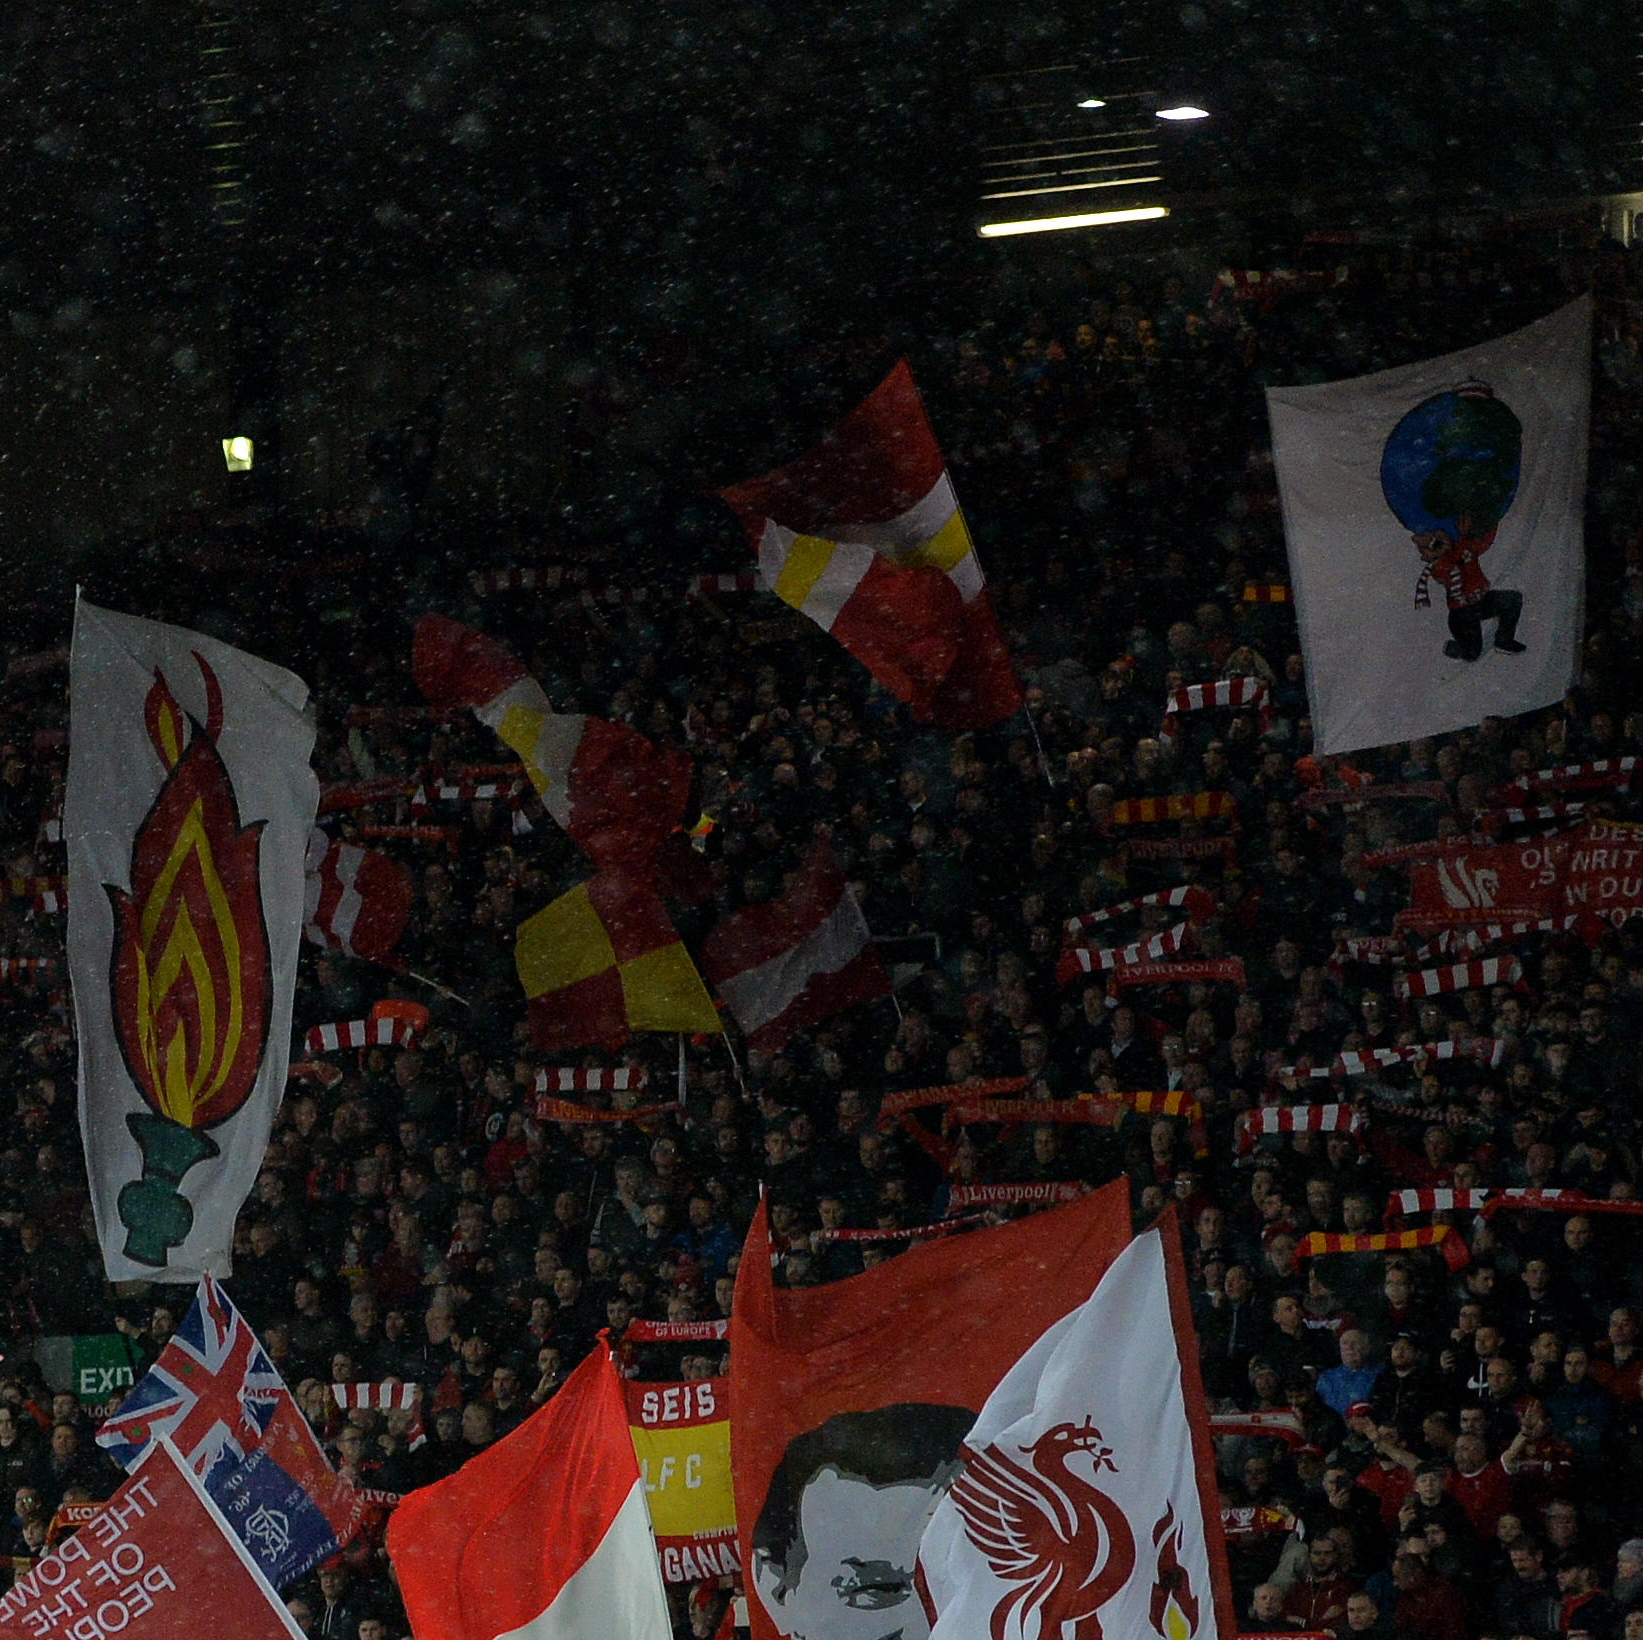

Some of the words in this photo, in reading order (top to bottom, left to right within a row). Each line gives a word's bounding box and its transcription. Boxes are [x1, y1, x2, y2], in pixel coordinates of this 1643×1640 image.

[969, 1183, 1053, 1203] Liverpool
[80, 1366, 135, 1395] EXIT
[641, 1382, 716, 1424] SEIS
